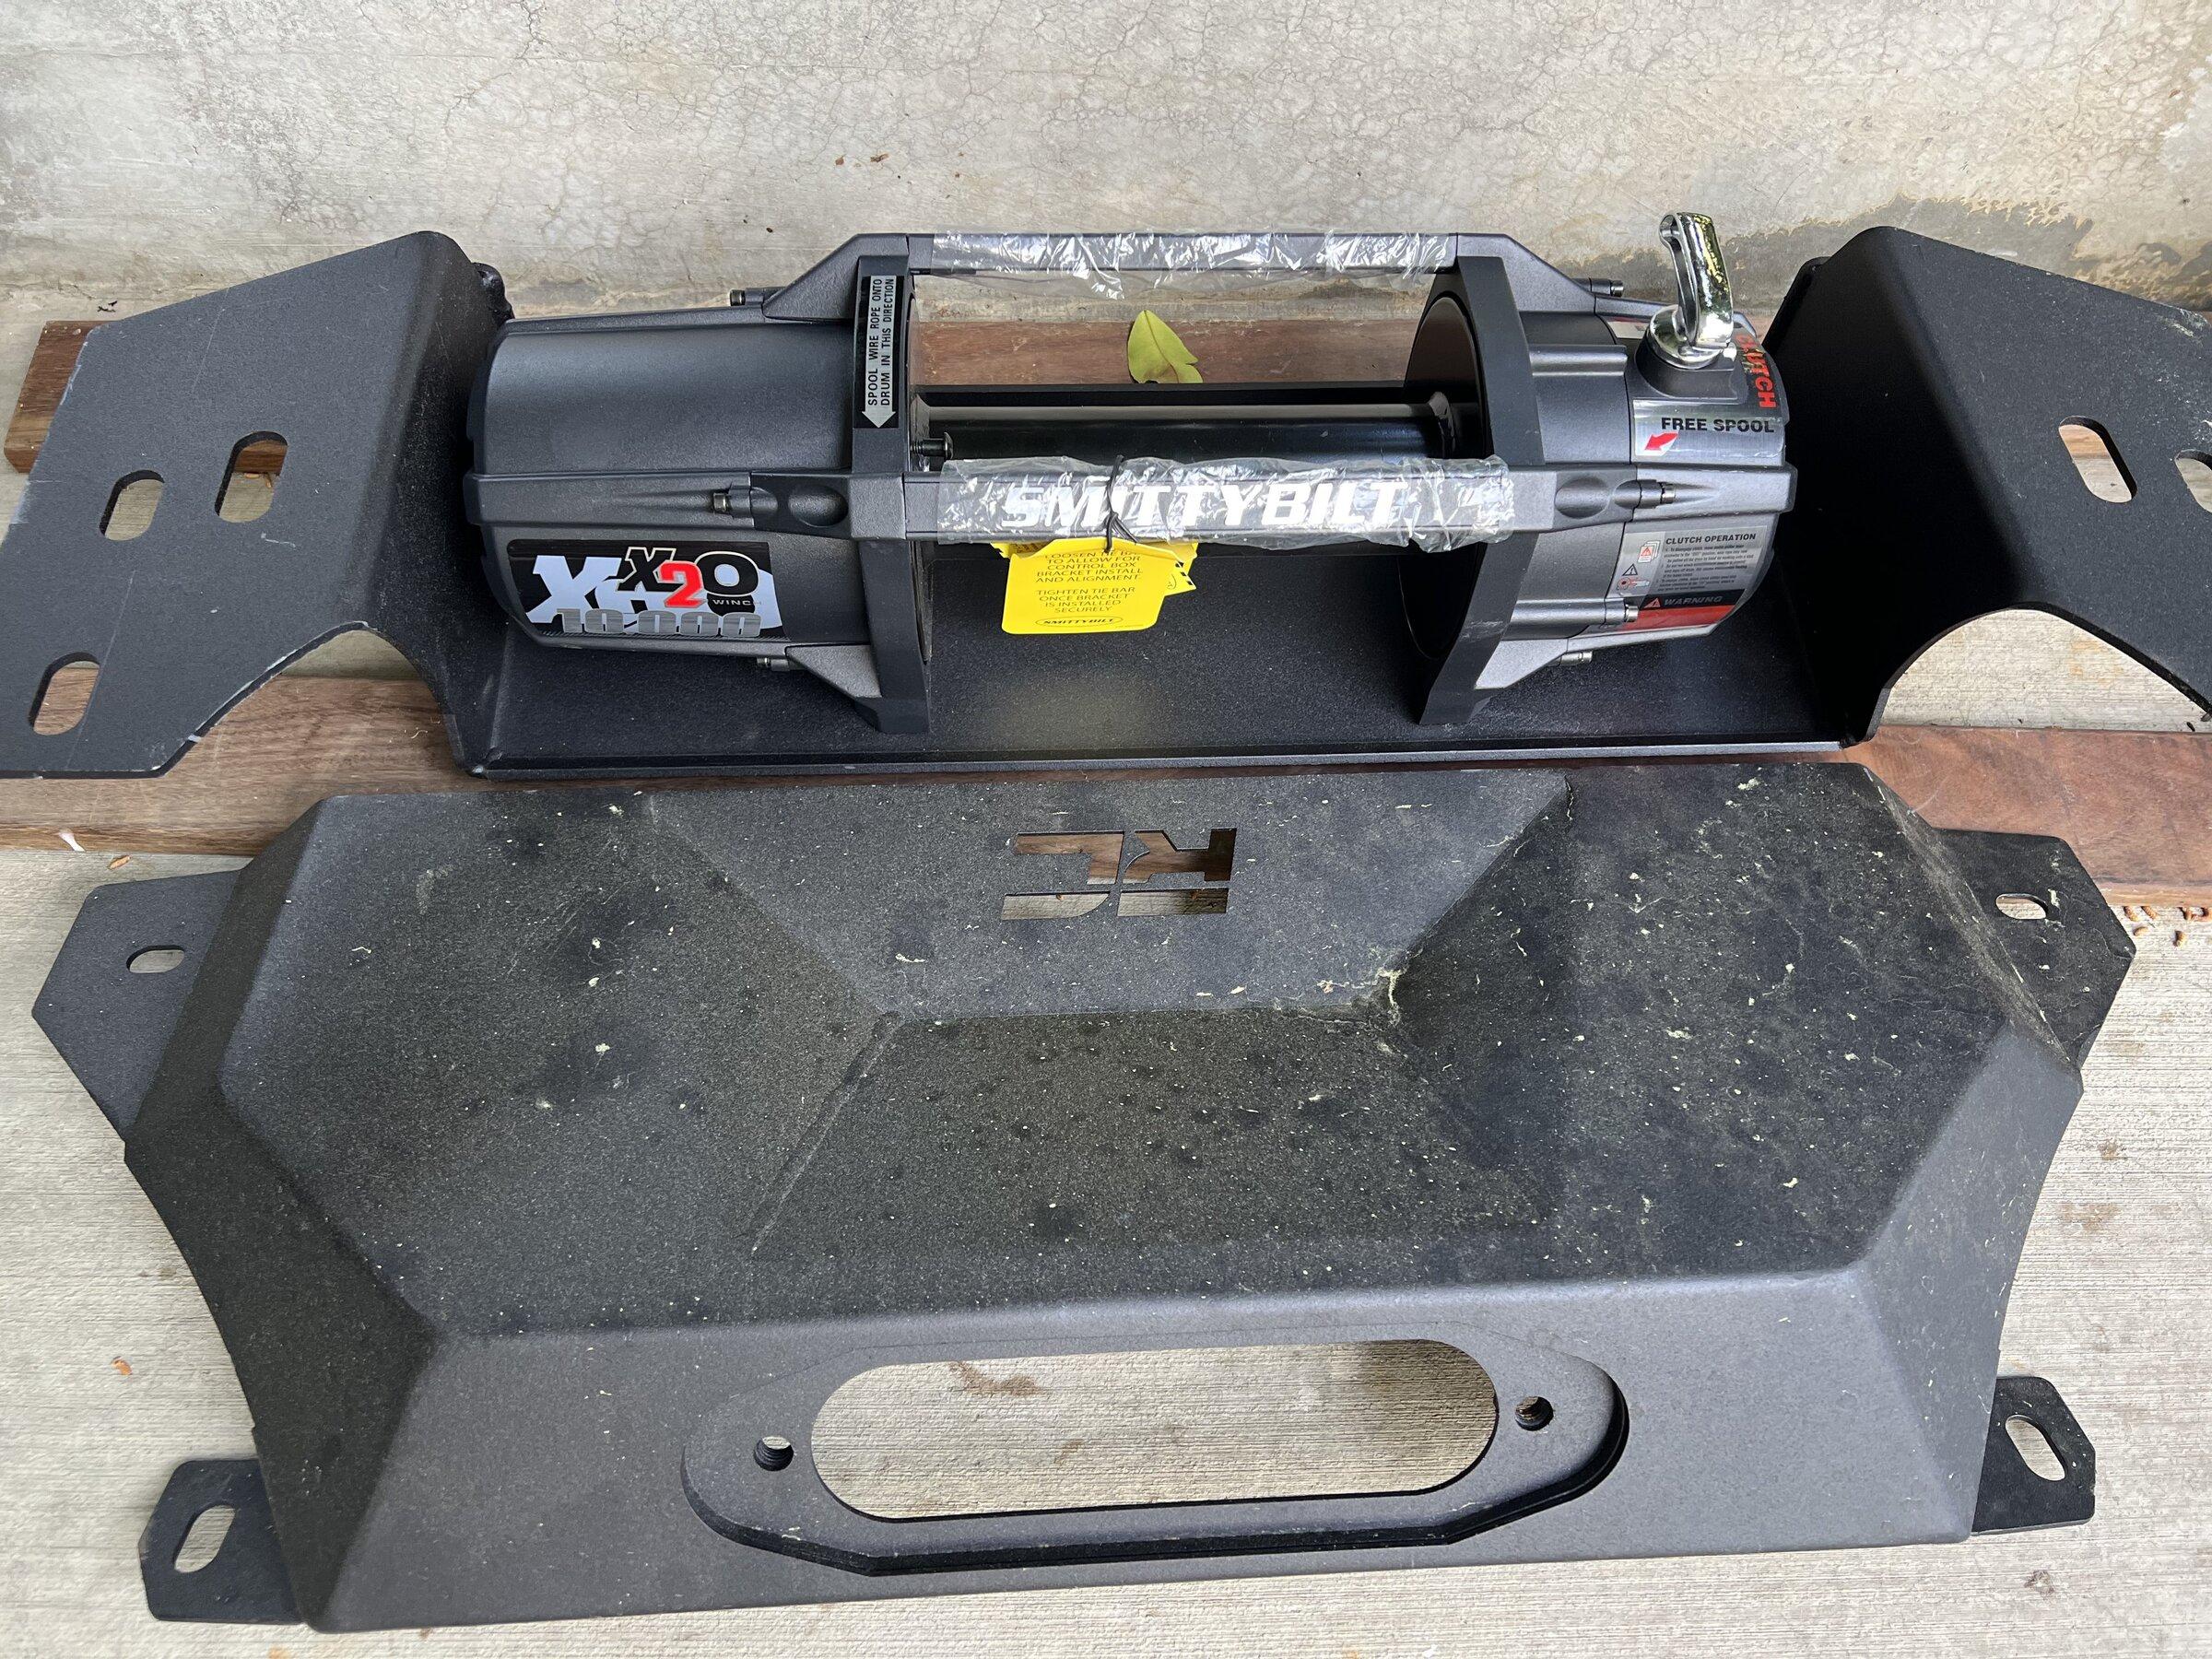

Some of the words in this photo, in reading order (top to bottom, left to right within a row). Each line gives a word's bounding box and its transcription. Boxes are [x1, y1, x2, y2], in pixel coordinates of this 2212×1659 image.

[872, 278, 883, 300] ONTO
[883, 278, 894, 323] DIRECTION
[870, 307, 881, 329] ROPE
[869, 335, 879, 360] WIRE
[881, 328, 892, 348] THIS
[881, 355, 891, 366] IN
[868, 369, 878, 406] SPOOL
[880, 372, 890, 406] DRUM
[1661, 418, 1708, 431] FREE
[1713, 418, 1775, 433] SPOOL
[1002, 482, 1408, 527] SMITTYBILT
[1665, 536, 1702, 545] CLUTCH
[1704, 534, 1757, 543] OPERATION
[1058, 599, 1122, 607] INSTALLED
[1665, 595, 1724, 606] WARNING
